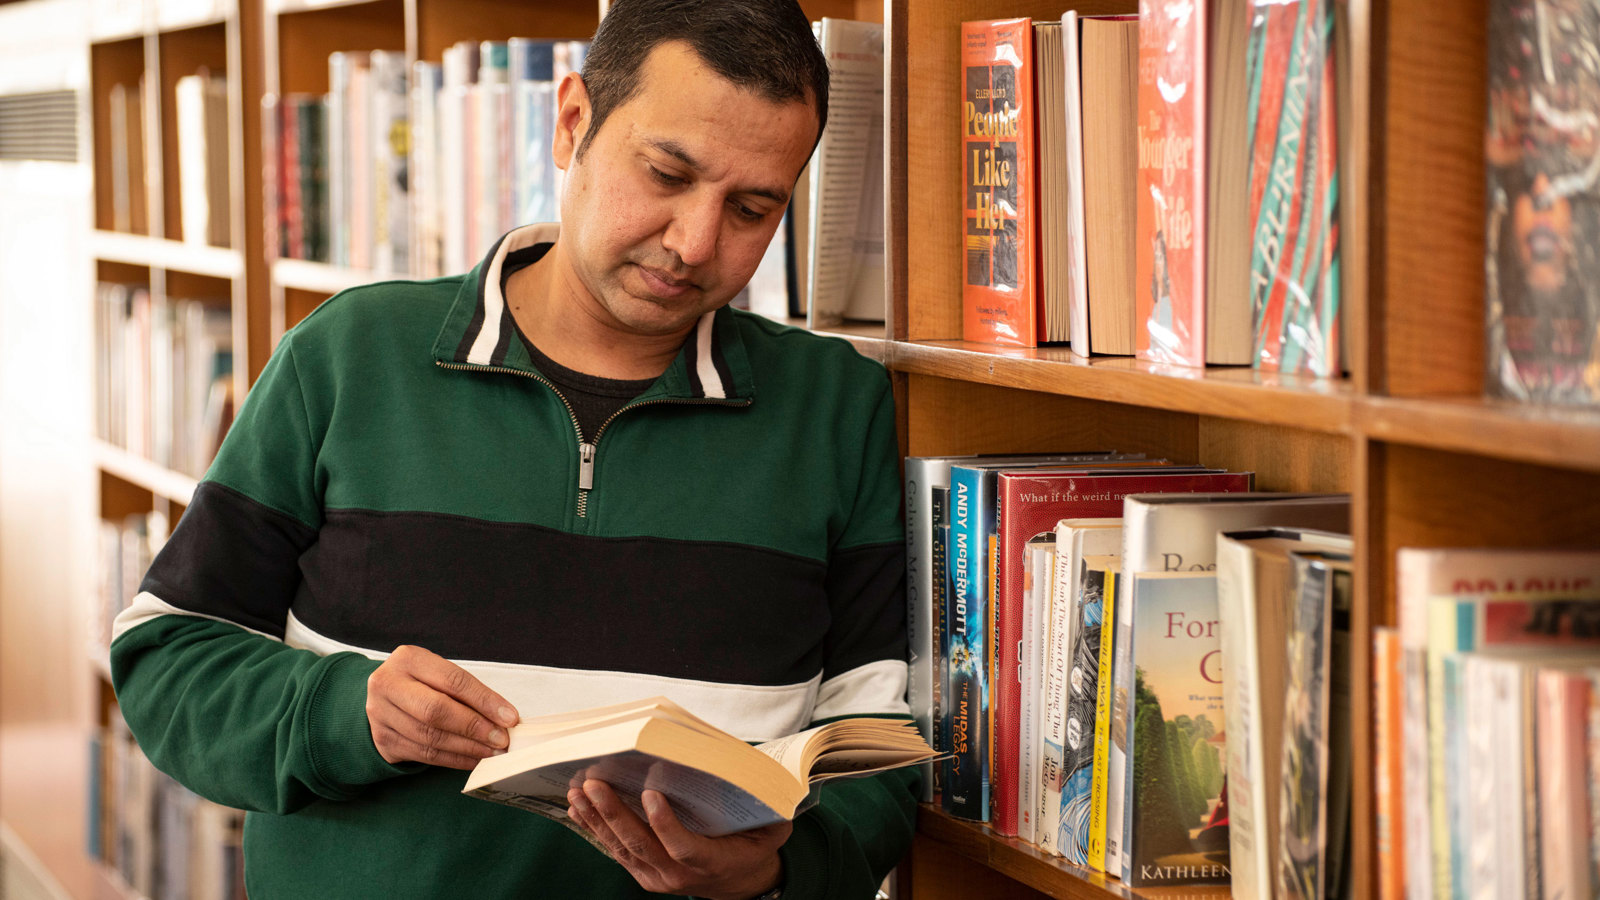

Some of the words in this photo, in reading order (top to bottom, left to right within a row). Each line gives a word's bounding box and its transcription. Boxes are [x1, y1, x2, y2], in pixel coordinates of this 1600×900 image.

[964, 100, 1018, 148] People
[973, 148, 1010, 187] Like
[1137, 125, 1193, 187] Younger
[976, 192, 1005, 230] Her
[908, 479, 917, 547] Colum
[957, 482, 968, 529] ANDY
[1020, 492, 1048, 503] What
[1051, 492, 1060, 502] if
[1062, 491, 1079, 502] the
[1081, 491, 1110, 502] weird
[1113, 493, 1126, 502] ne
[933, 501, 941, 531] The
[1059, 552, 1069, 578] This
[1162, 552, 1216, 572] Ros
[908, 555, 917, 639] McCann
[1058, 581, 1068, 604] Isn't
[1058, 606, 1067, 629] The
[1164, 612, 1219, 639] For
[933, 625, 941, 671] Grace
[1057, 630, 1066, 656] Sort
[1056, 657, 1065, 674] Of
[1047, 672, 1055, 699] Like
[1051, 675, 1063, 711] Thing
[933, 681, 941, 751] McCleen
[960, 701, 968, 754] MIDAS
[1052, 713, 1062, 739] That
[1041, 755, 1050, 817] McGregor
[1049, 757, 1059, 782] Jon
[1094, 775, 1102, 829] CROSSING
[1141, 864, 1232, 881] KATHLEEN
